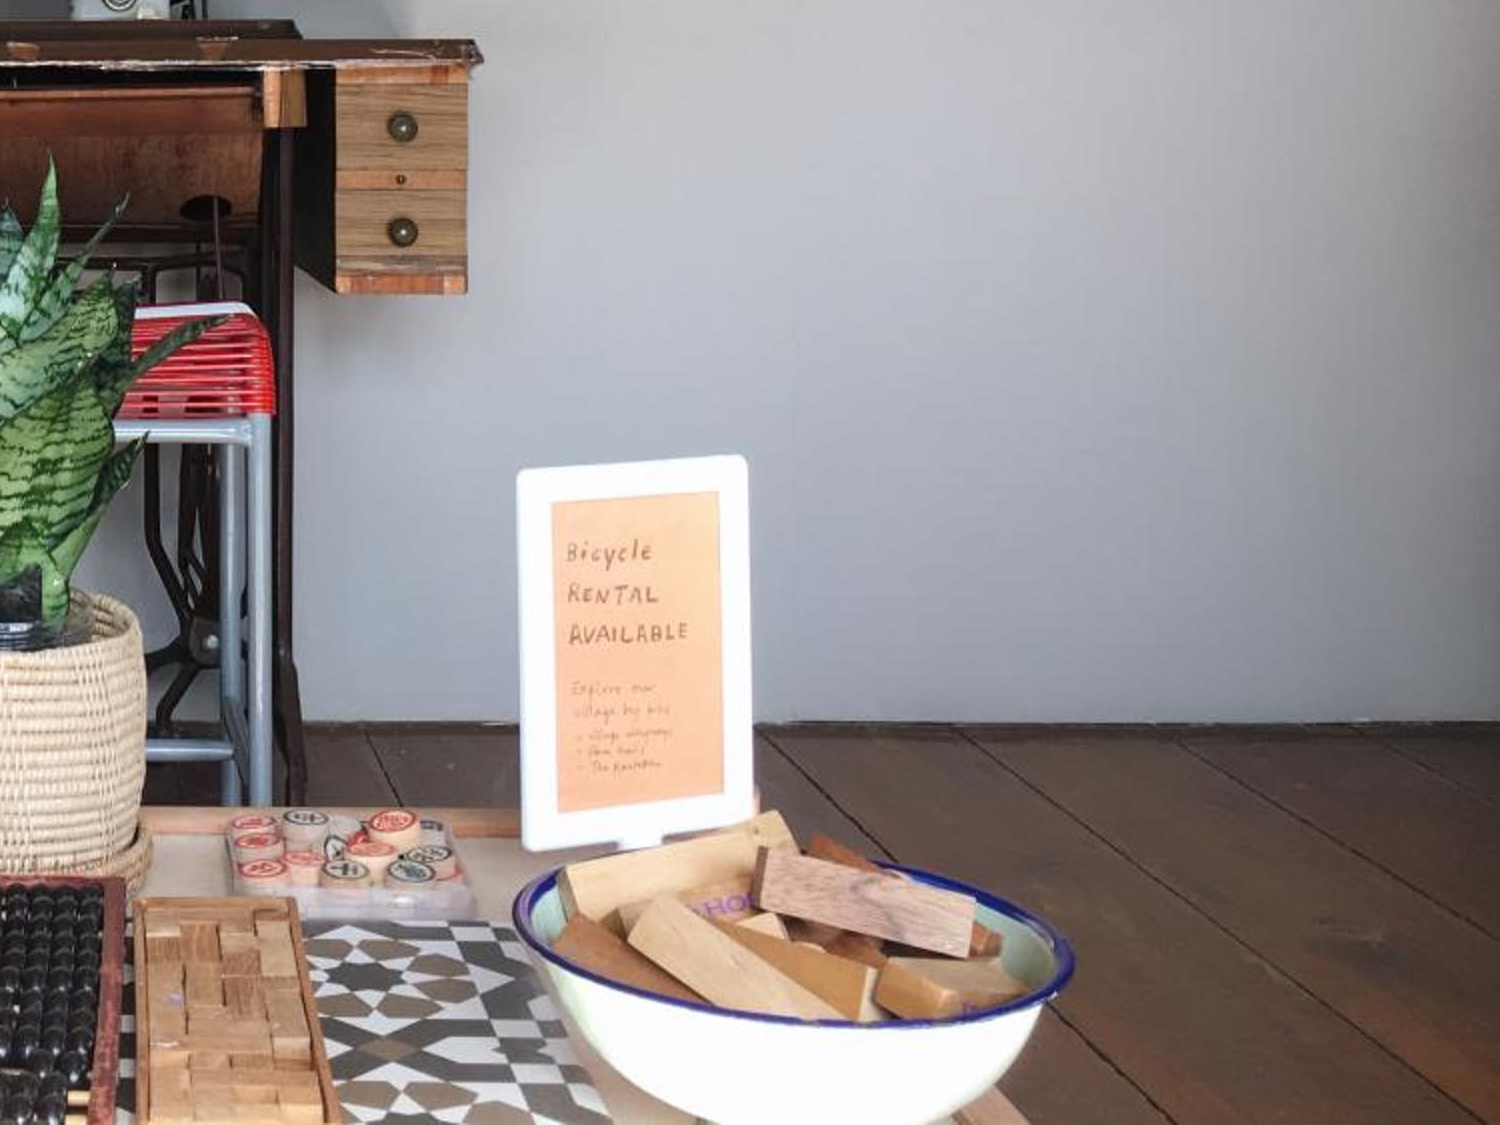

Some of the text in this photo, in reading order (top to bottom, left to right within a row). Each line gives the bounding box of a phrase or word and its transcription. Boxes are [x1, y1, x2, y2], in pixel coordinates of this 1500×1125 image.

[566, 537, 653, 572] Bicycle
[567, 581, 660, 606] RENTAL
[568, 621, 689, 646] AVAILABLE
